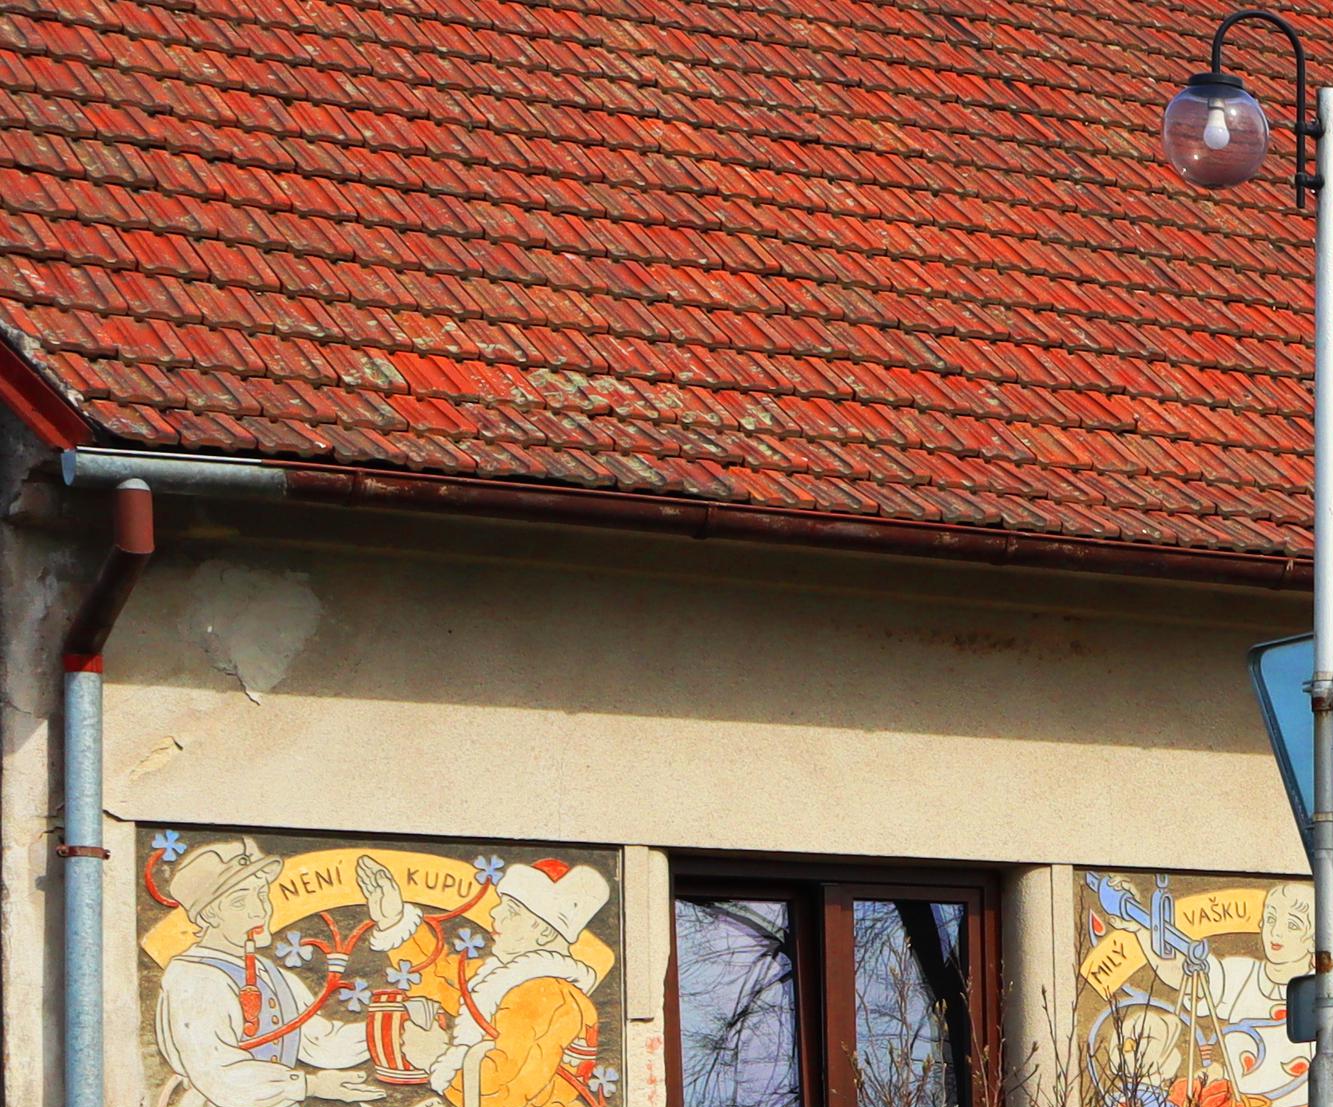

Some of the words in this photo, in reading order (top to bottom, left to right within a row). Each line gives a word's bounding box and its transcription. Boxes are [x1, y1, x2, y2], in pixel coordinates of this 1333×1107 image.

[279, 860, 343, 900] NENÍ
[406, 868, 472, 898] KUPU
[1091, 940, 1127, 984] MILÝ
[1183, 896, 1251, 926] VAŠKU,
